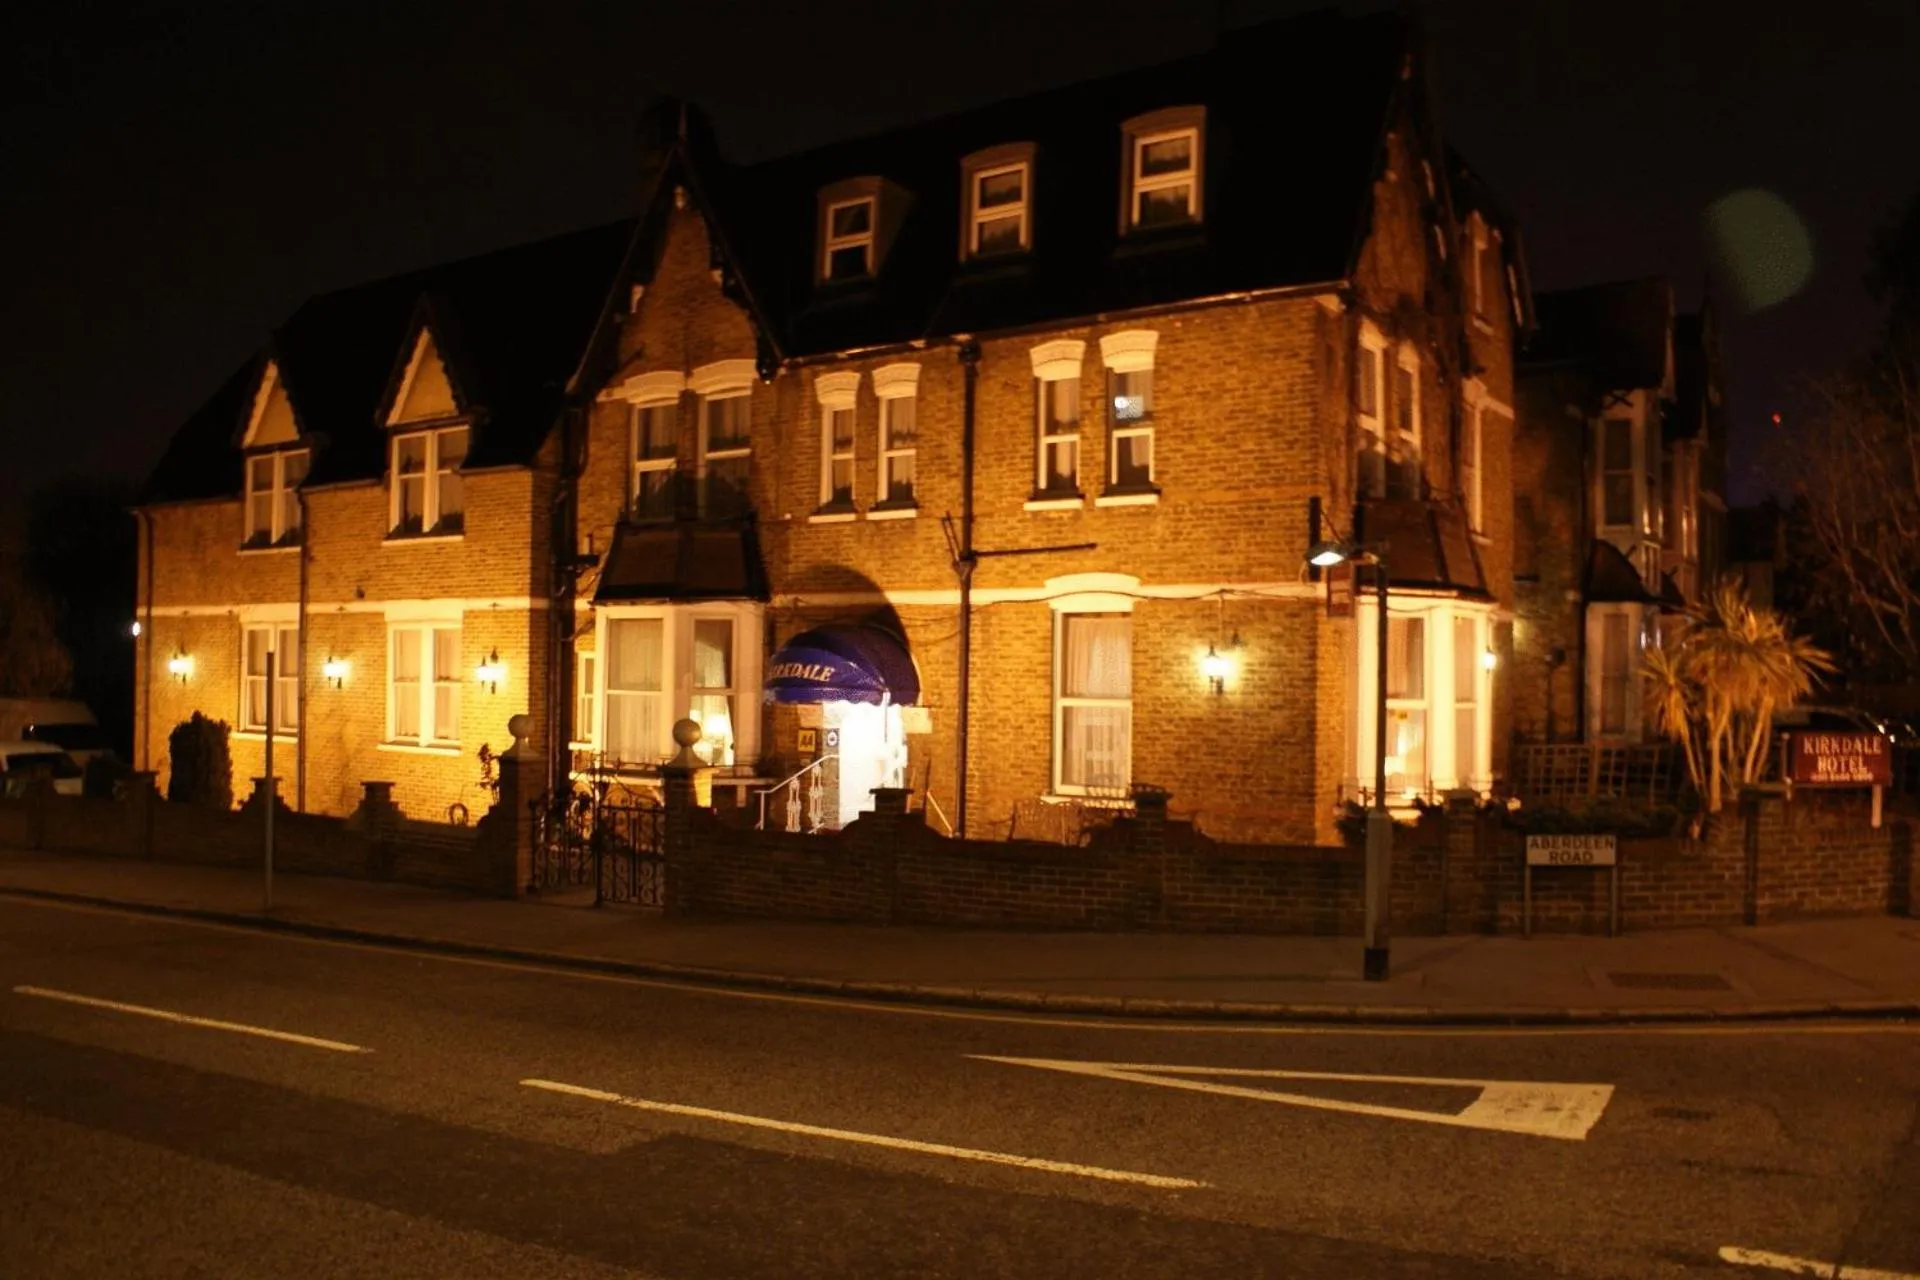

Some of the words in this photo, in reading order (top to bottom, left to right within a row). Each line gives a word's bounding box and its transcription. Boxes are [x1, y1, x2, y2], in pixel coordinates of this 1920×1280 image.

[770, 662, 836, 682] RKDALE
[1803, 735, 1882, 755] KIRKDALE
[1816, 755, 1868, 772] HOTEL
[1529, 836, 1614, 850] ABERDEEN
[1548, 850, 1595, 864] ROAD
